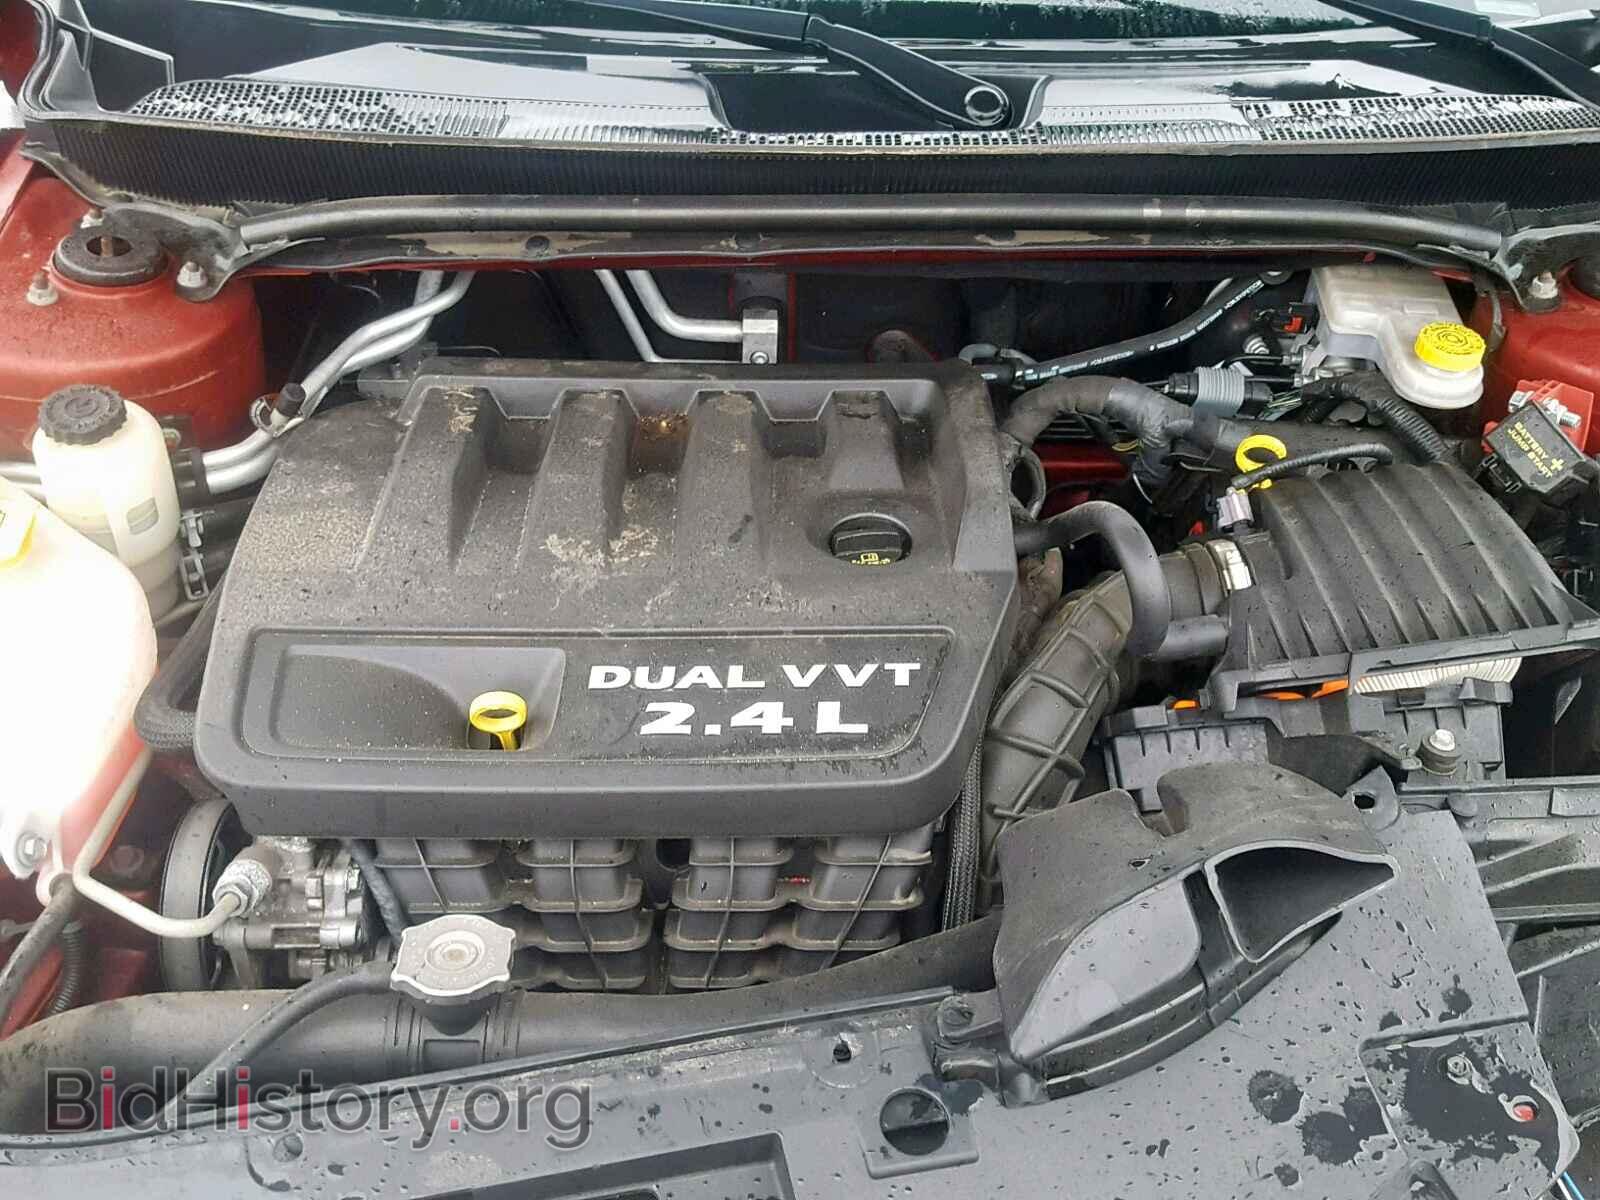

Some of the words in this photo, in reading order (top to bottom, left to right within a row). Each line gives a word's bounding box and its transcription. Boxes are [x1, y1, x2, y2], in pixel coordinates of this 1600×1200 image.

[1507, 428, 1530, 452] JUMP
[1527, 452, 1553, 478] START
[1515, 421, 1549, 460] BATTERY
[588, 665, 766, 690] DUAL
[782, 662, 921, 688] VVT
